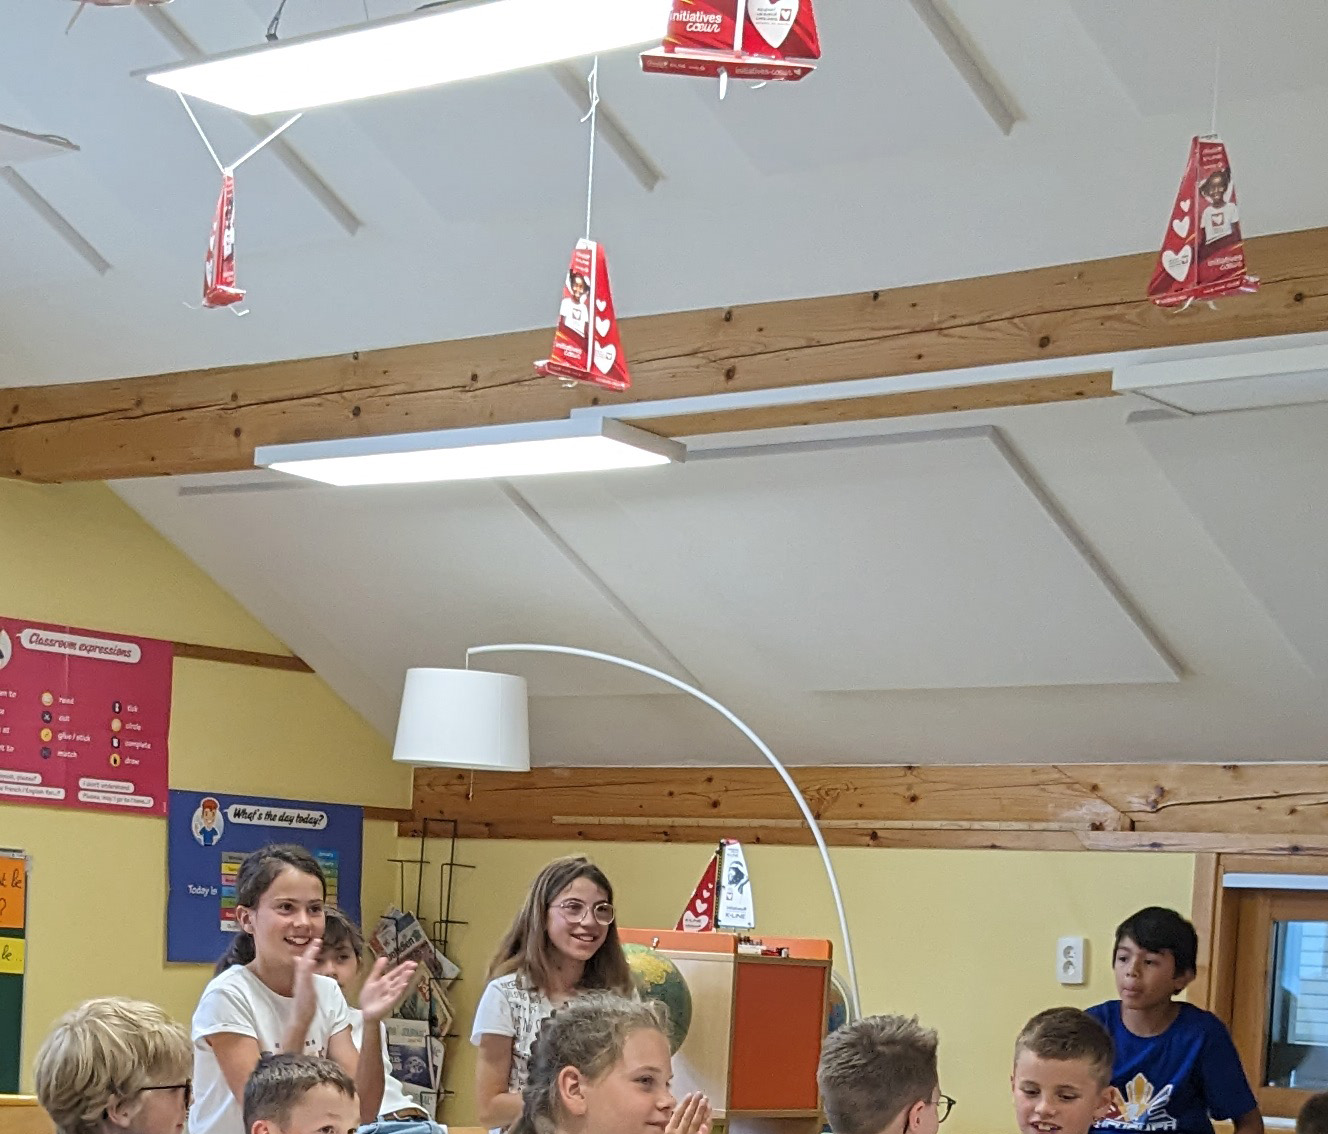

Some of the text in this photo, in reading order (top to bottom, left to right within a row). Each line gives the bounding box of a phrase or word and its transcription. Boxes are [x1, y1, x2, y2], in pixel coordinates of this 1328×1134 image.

[29, 632, 134, 659] Classroom expressions
[233, 807, 325, 828] What's the day today?
[11, 868, 22, 889] be
[187, 884, 218, 897] Today is
